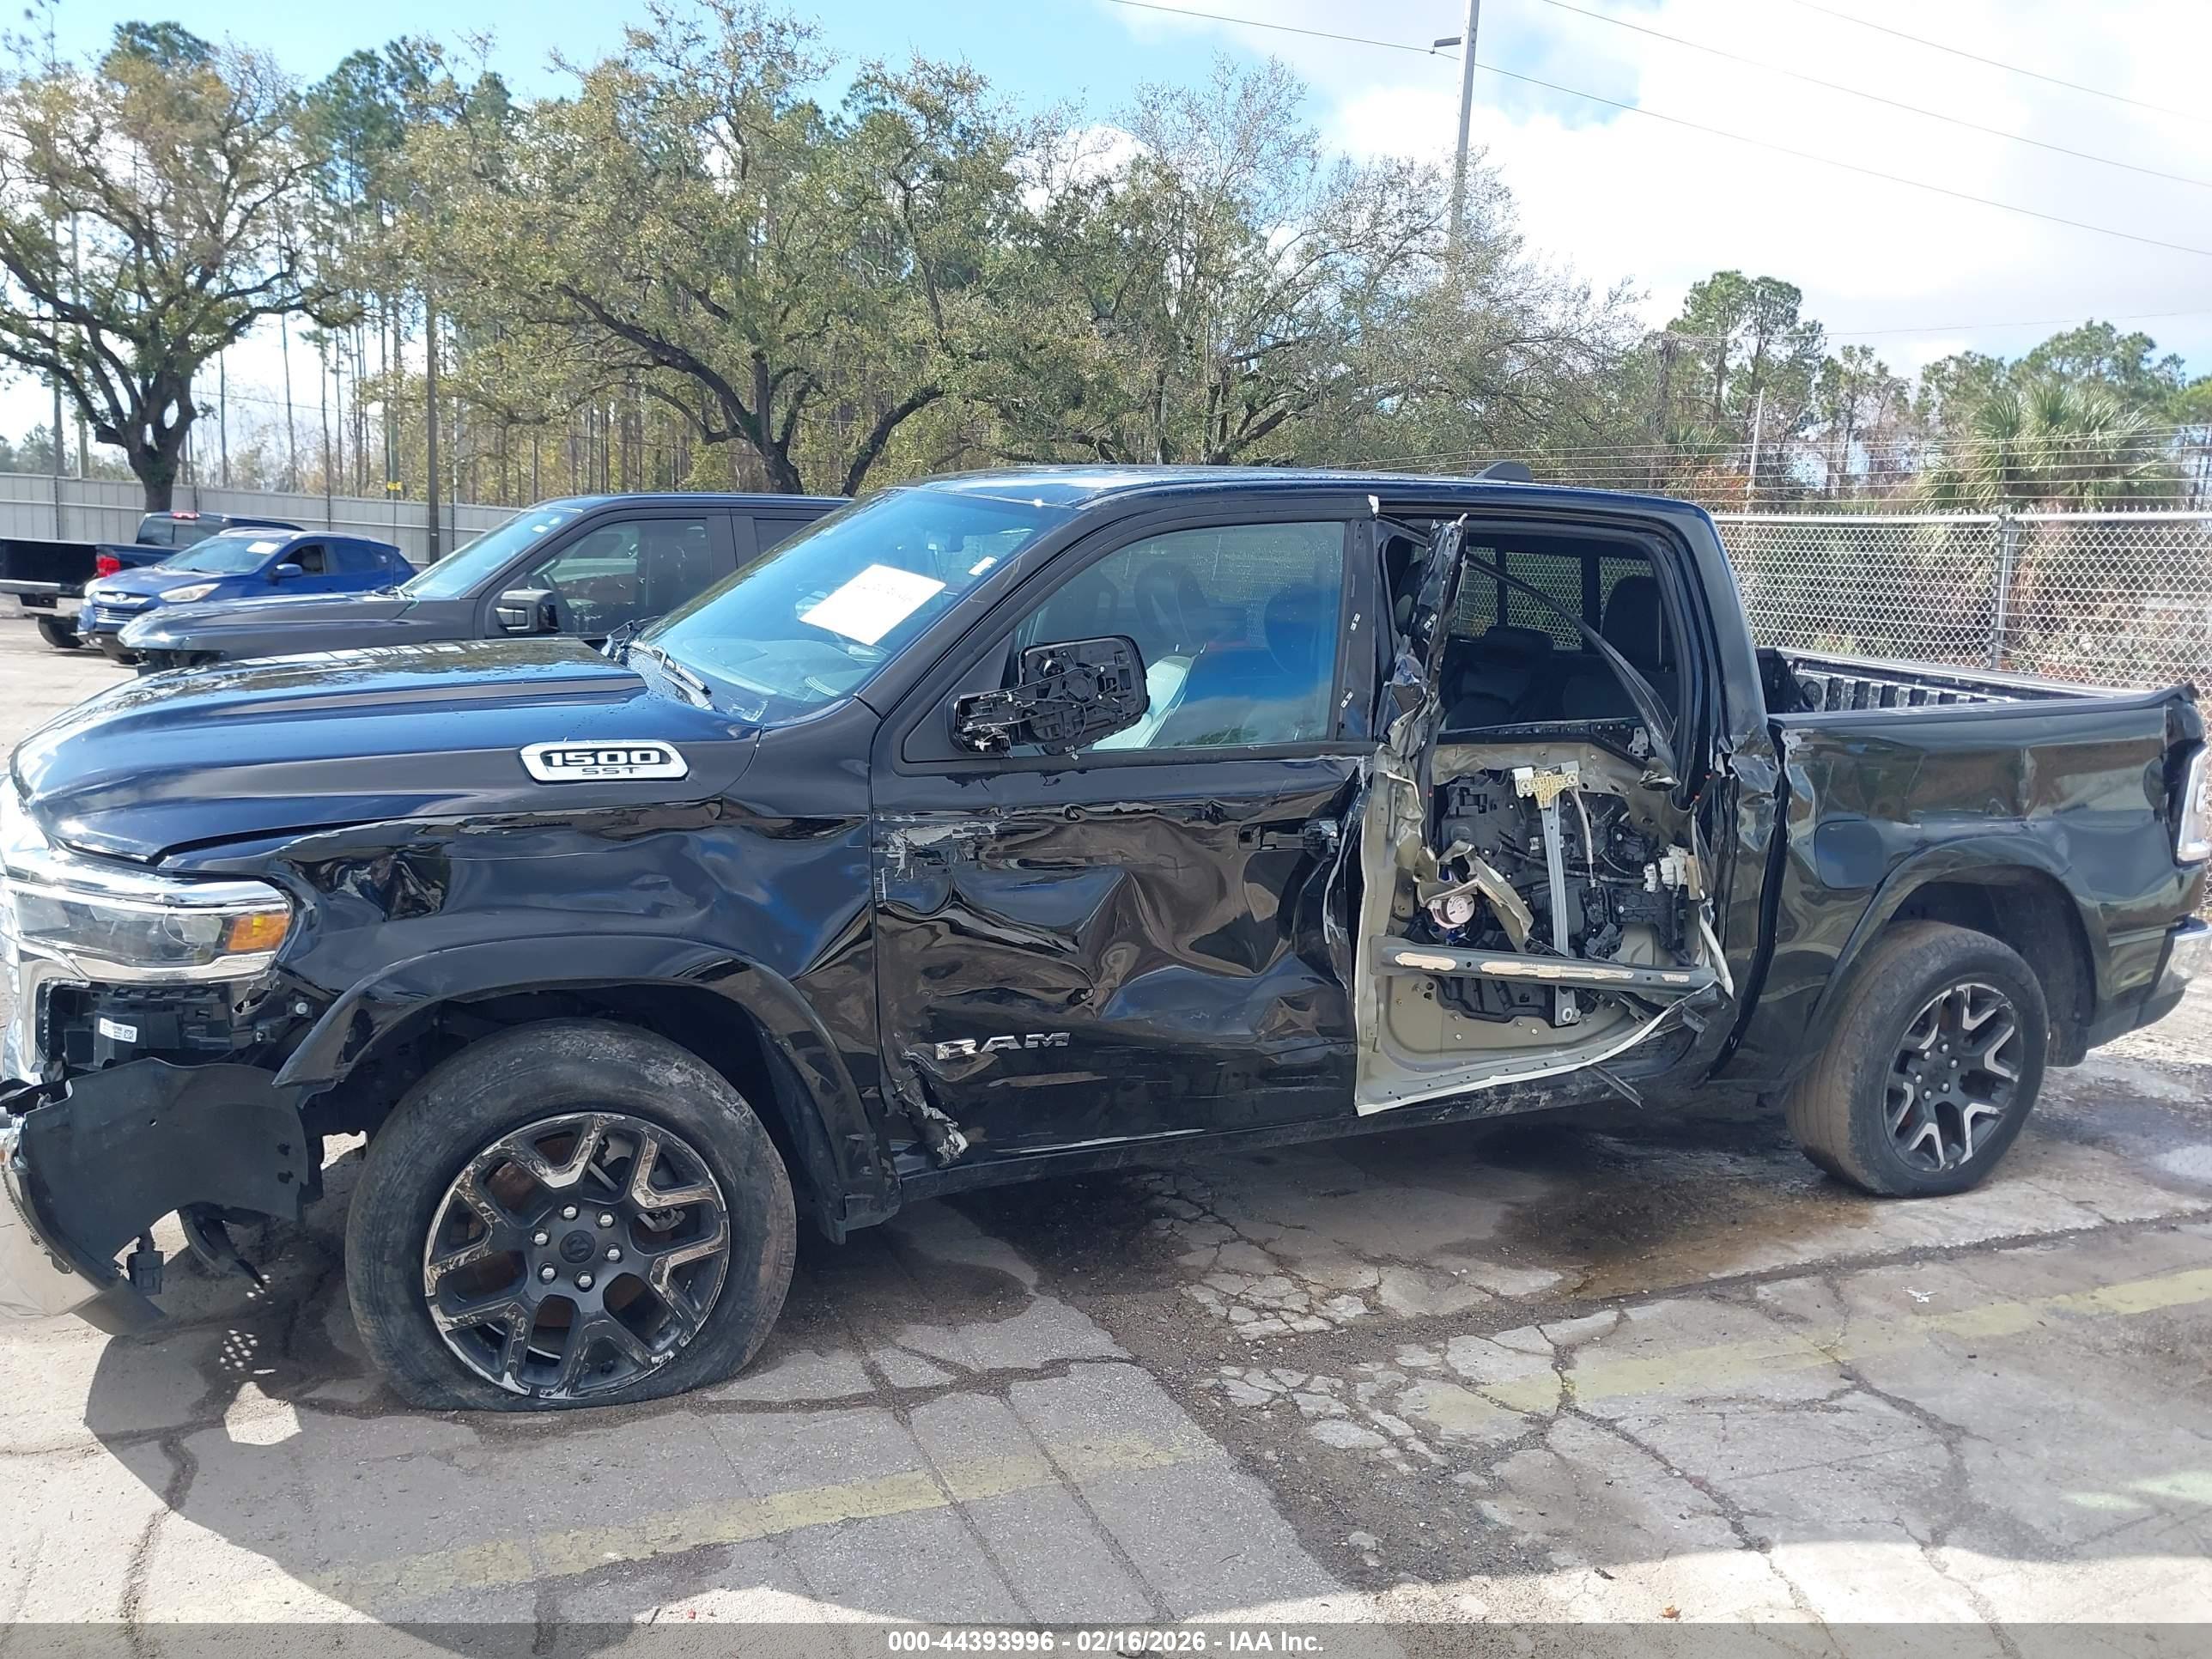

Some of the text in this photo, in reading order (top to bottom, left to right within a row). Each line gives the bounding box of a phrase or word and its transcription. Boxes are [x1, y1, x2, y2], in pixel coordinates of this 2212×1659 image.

[545, 750, 661, 767] 1500
[581, 766, 641, 775] SST
[934, 1032, 1071, 1060] RAM
